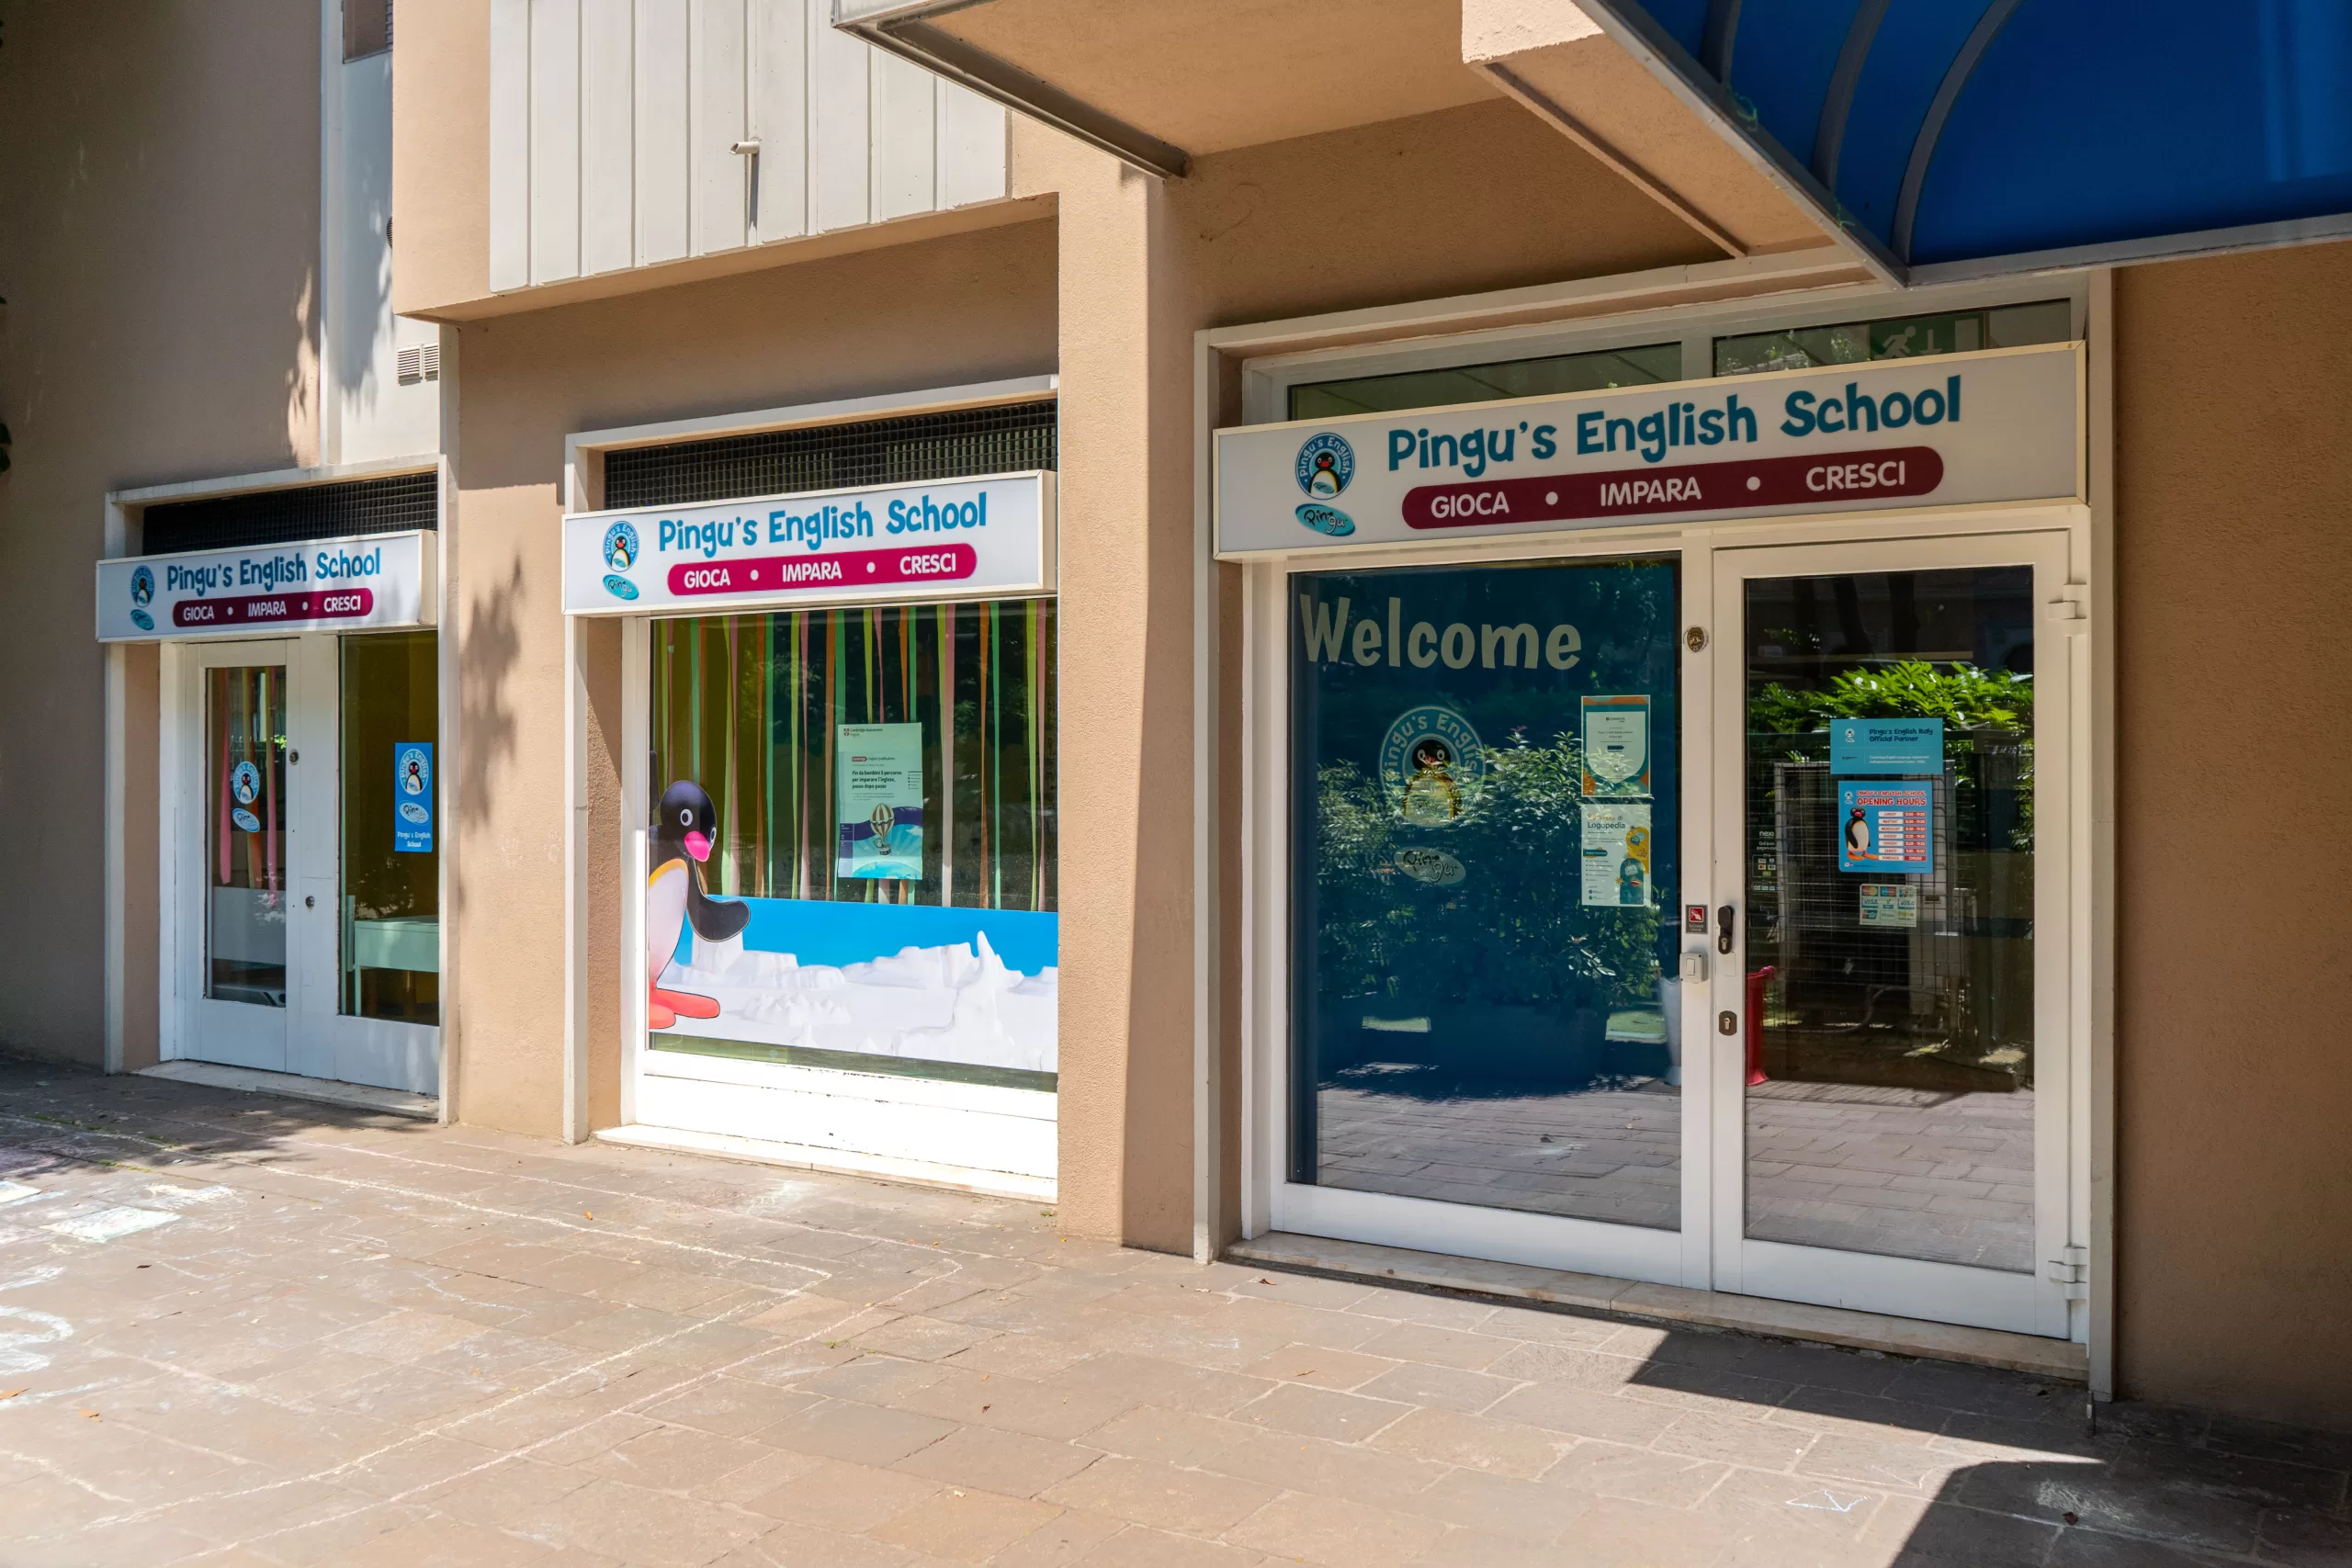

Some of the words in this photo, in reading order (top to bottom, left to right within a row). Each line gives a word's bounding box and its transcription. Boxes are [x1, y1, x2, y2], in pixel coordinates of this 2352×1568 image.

[1387, 419, 1557, 478] Pingu's
[1577, 394, 1758, 463] English
[1780, 375, 1962, 438] School
[1299, 439, 1323, 477] Pingu's
[1328, 436, 1351, 474] English
[1430, 491, 1510, 519] GIOCA
[1600, 477, 1702, 507] IMPARA
[1804, 461, 1907, 491] CRESCI
[605, 525, 620, 554] Pingu's
[622, 525, 637, 553] English
[659, 515, 759, 558] Pingu's
[768, 502, 874, 550] English
[886, 491, 988, 535] School
[1304, 509, 1346, 534] Pingu
[167, 563, 232, 597] Pingu's
[240, 553, 307, 592] English
[315, 547, 380, 580] School
[607, 579, 633, 598] Pingu
[684, 568, 730, 589] GIOCA
[782, 560, 842, 582] IMPARA
[899, 552, 956, 575] CRESCI
[183, 604, 215, 621] GIOCA
[248, 601, 287, 617] IMPARA
[323, 595, 361, 612] CRESCI
[1298, 594, 1582, 671] Welcome
[1857, 797, 1894, 806] OPENING
[1896, 797, 1926, 806] HOURS
[1588, 822, 1625, 830] Logopedia
